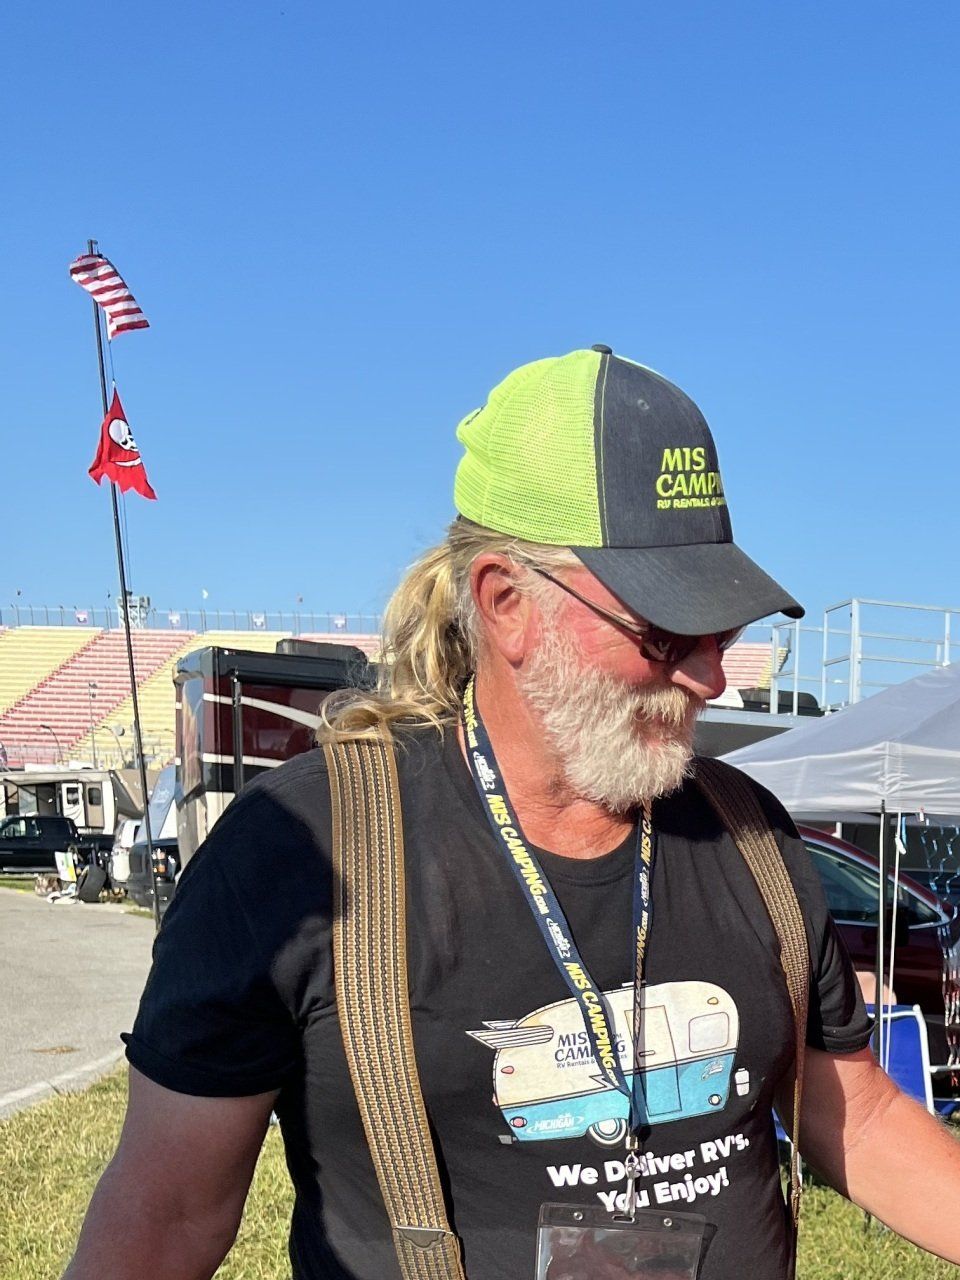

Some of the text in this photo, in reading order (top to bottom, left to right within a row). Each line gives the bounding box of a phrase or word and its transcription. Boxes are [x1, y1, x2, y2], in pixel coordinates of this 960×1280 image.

[661, 447, 706, 472] MIS
[656, 499, 671, 509] RV
[673, 497, 710, 509] RENTALS
[486, 793, 512, 826] MIS
[563, 961, 592, 990] MIS
[558, 1031, 588, 1048] MIS
[567, 1059, 589, 1068] Rentals
[547, 1163, 599, 1188] We
[653, 1166, 730, 1205] Enjoy!
